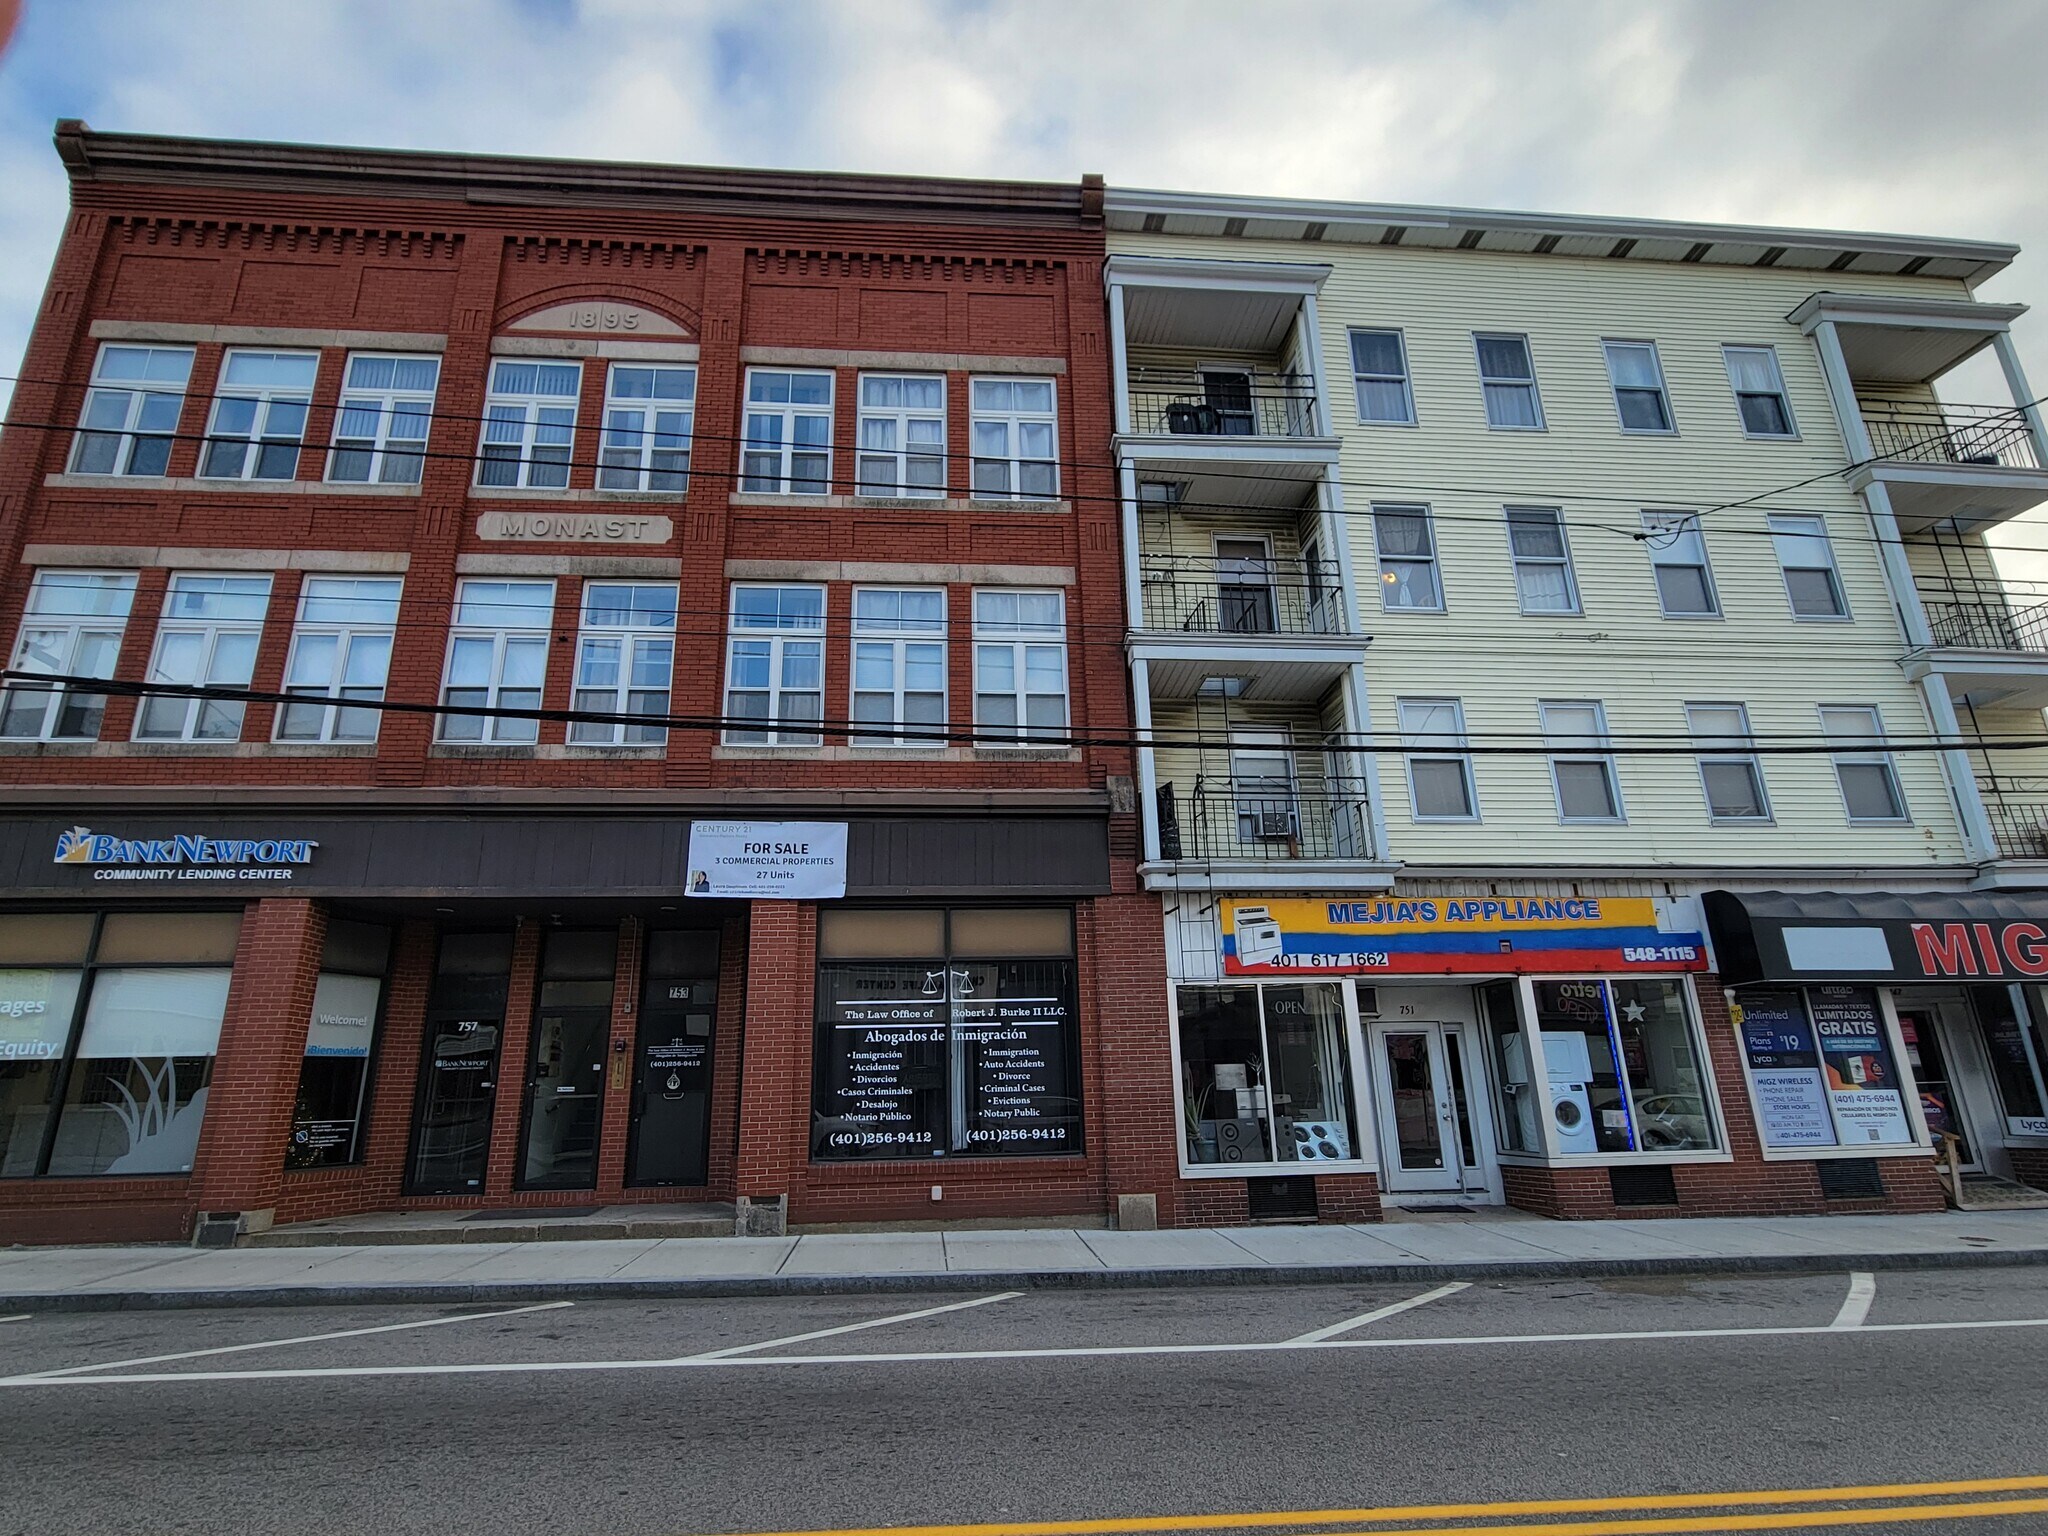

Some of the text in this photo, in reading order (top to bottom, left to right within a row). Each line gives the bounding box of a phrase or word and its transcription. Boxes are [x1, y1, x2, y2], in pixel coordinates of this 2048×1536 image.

[569, 310, 640, 329] 1895
[500, 516, 649, 538] MONAST
[744, 843, 809, 854] FOR SALE
[715, 857, 720, 865] 3
[722, 857, 780, 865] COMMERCIAL
[94, 869, 292, 880] COMMUNITY LENDING CENTER
[756, 870, 795, 879] 27 Units
[1326, 899, 1602, 924] MEJIA'S APPLIANCE
[1625, 947, 1696, 961] 548-1115
[1910, 922, 2048, 976] MIG
[1271, 952, 1387, 967] 401 617 1662
[670, 987, 688, 998] 753
[0, 1000, 46, 1017] ages
[1275, 1001, 1306, 1014] OPEN
[1400, 1005, 1415, 1015] 751
[845, 1007, 1067, 1019] The Law Office of Robert J. Burke II LLC.
[1744, 1010, 1789, 1020] Unlimited
[1815, 1010, 1873, 1019] ILIMITADOS
[320, 1014, 367, 1026] Welcome!
[458, 1021, 478, 1031] 757
[1818, 1021, 1877, 1035] GRATIS
[864, 1028, 1027, 1045] Abogados de Inmigración
[1750, 1036, 1771, 1045] Plans
[308, 1045, 368, 1055] ¡Bienvenido!
[989, 1048, 1040, 1058] Immigration
[852, 1051, 903, 1061] Inmigración
[1753, 1055, 1773, 1064] Lyca
[854, 1063, 900, 1071] Accidentes
[983, 1060, 1045, 1069] Auto Accidents
[857, 1075, 897, 1083] Divorcios
[998, 1072, 1031, 1080] Divorce
[841, 1086, 913, 1096] Casos Criminales
[984, 1083, 1046, 1093] Criminal Cases
[993, 1097, 1031, 1105] Evictions
[1834, 1095, 1855, 1103] (401)
[861, 1100, 898, 1110] Desalojo
[845, 1112, 911, 1121] Notario Público
[984, 1108, 1040, 1119] Notary Public
[830, 1132, 932, 1147] (401)256-9412
[966, 1128, 1066, 1143] (401)256-9412
